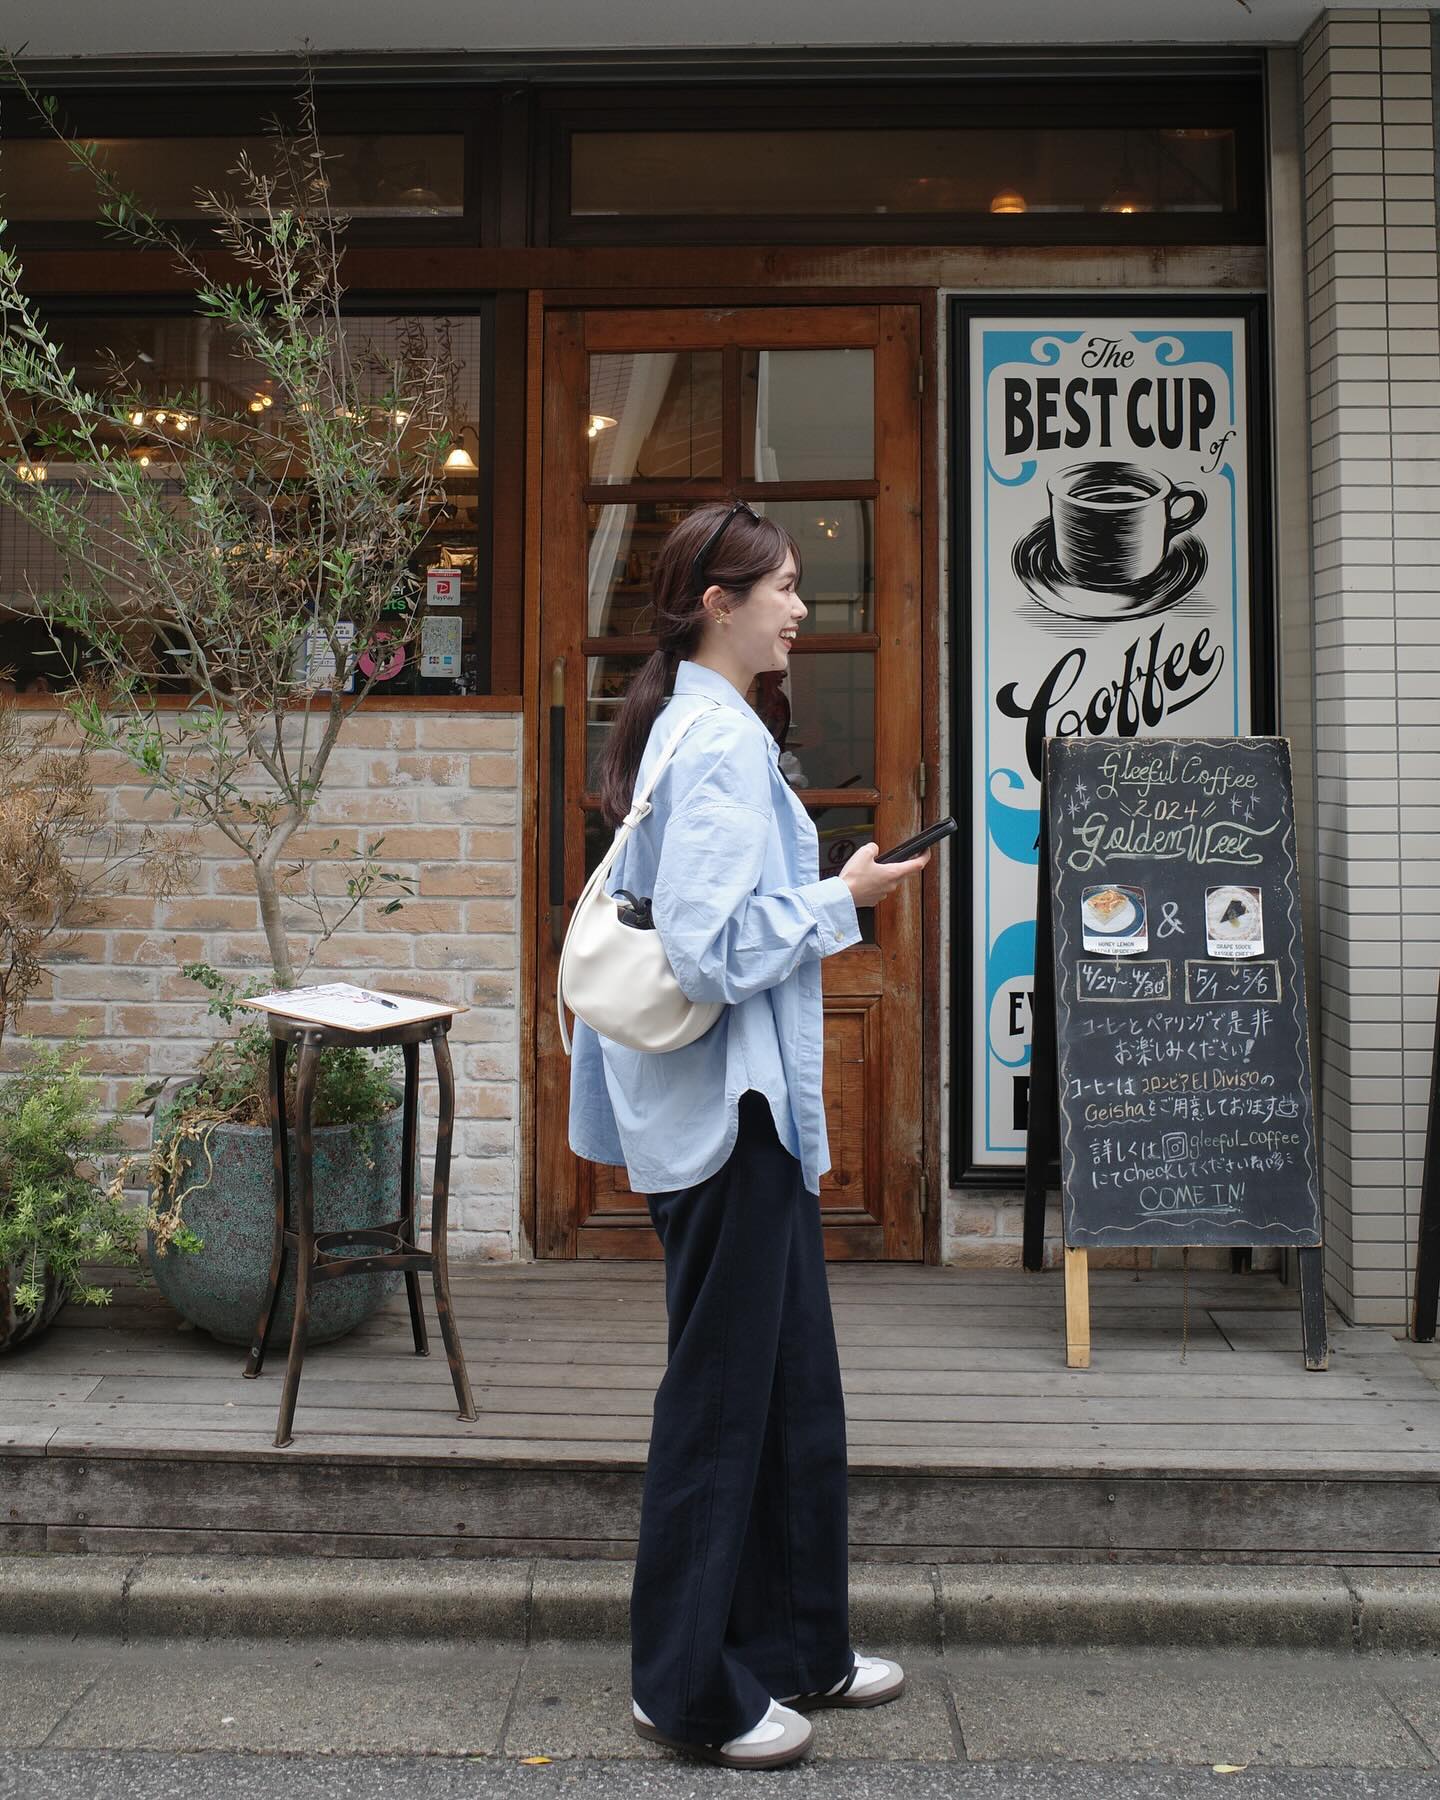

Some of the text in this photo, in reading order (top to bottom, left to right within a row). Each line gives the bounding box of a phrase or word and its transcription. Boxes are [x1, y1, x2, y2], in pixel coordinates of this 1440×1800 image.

[1081, 336, 1135, 369] The
[1004, 377, 1216, 456] BEST CUP
[1200, 430, 1237, 474] of
[432, 594, 455, 602] PayPay
[996, 622, 1225, 780] Coffee
[1096, 749, 1258, 799] Gleeful Coffee
[1132, 799, 1199, 821] 2024
[1068, 812, 1272, 872] Golden Week
[1156, 901, 1185, 938] &
[1139, 1181, 1246, 1211] COME IN!
